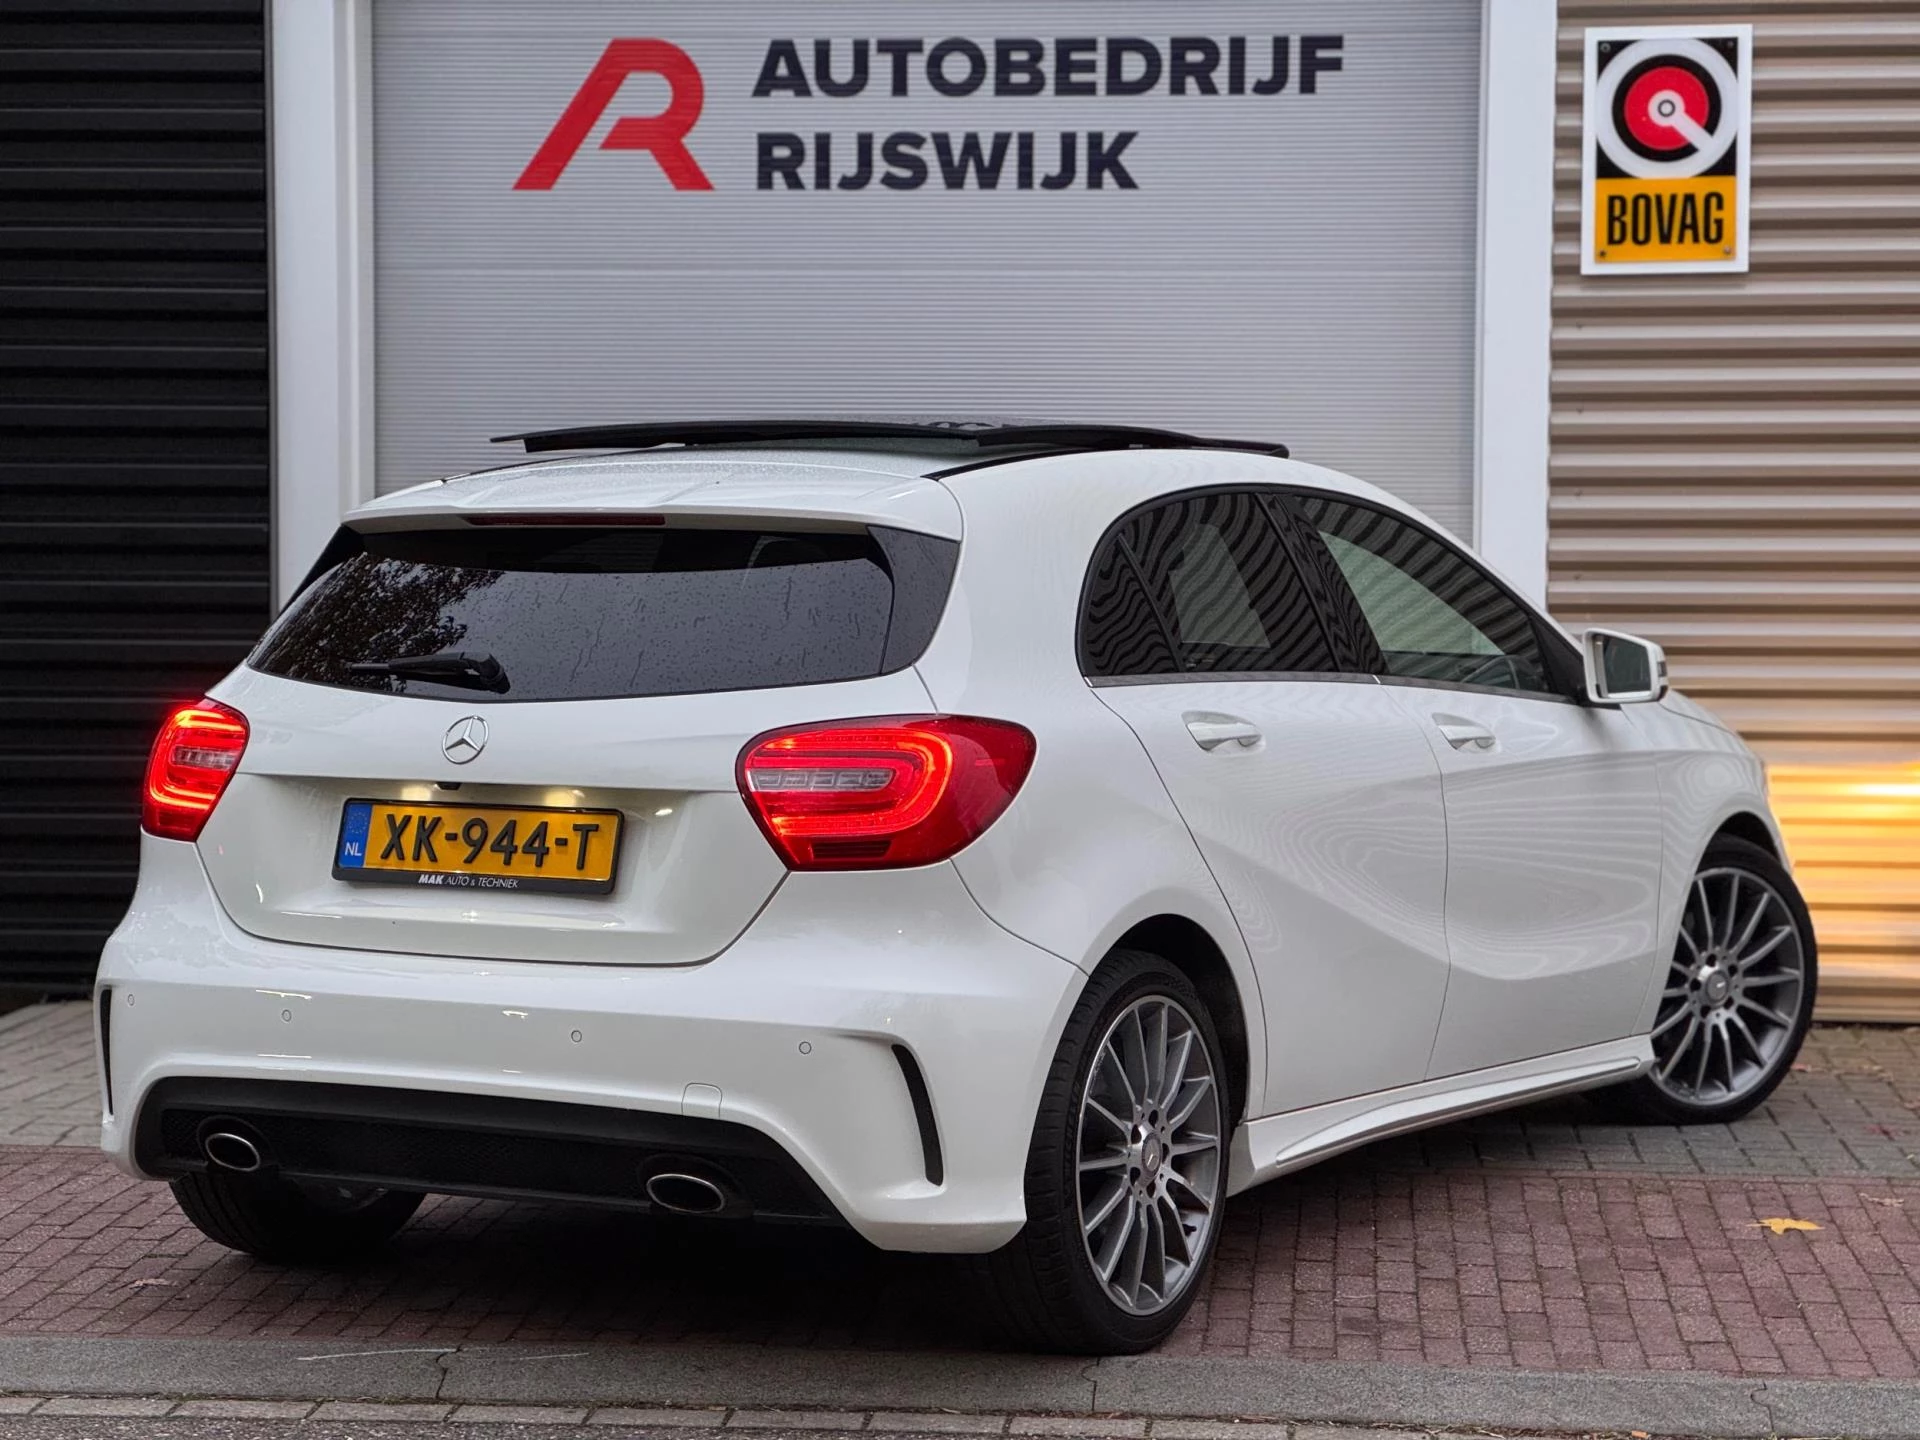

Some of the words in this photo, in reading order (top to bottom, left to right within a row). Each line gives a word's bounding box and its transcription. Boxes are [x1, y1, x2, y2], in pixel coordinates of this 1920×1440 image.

[752, 35, 1344, 97] AUTOBEDRIJF
[757, 131, 1139, 191] RIJSWIJK
[1607, 191, 1725, 246] BOVAG
[344, 842, 362, 857] NL
[380, 813, 600, 870] XK-944-T
[418, 874, 443, 885] MAK
[445, 876, 470, 887] AUTO
[478, 877, 520, 889] TECHNIEK
